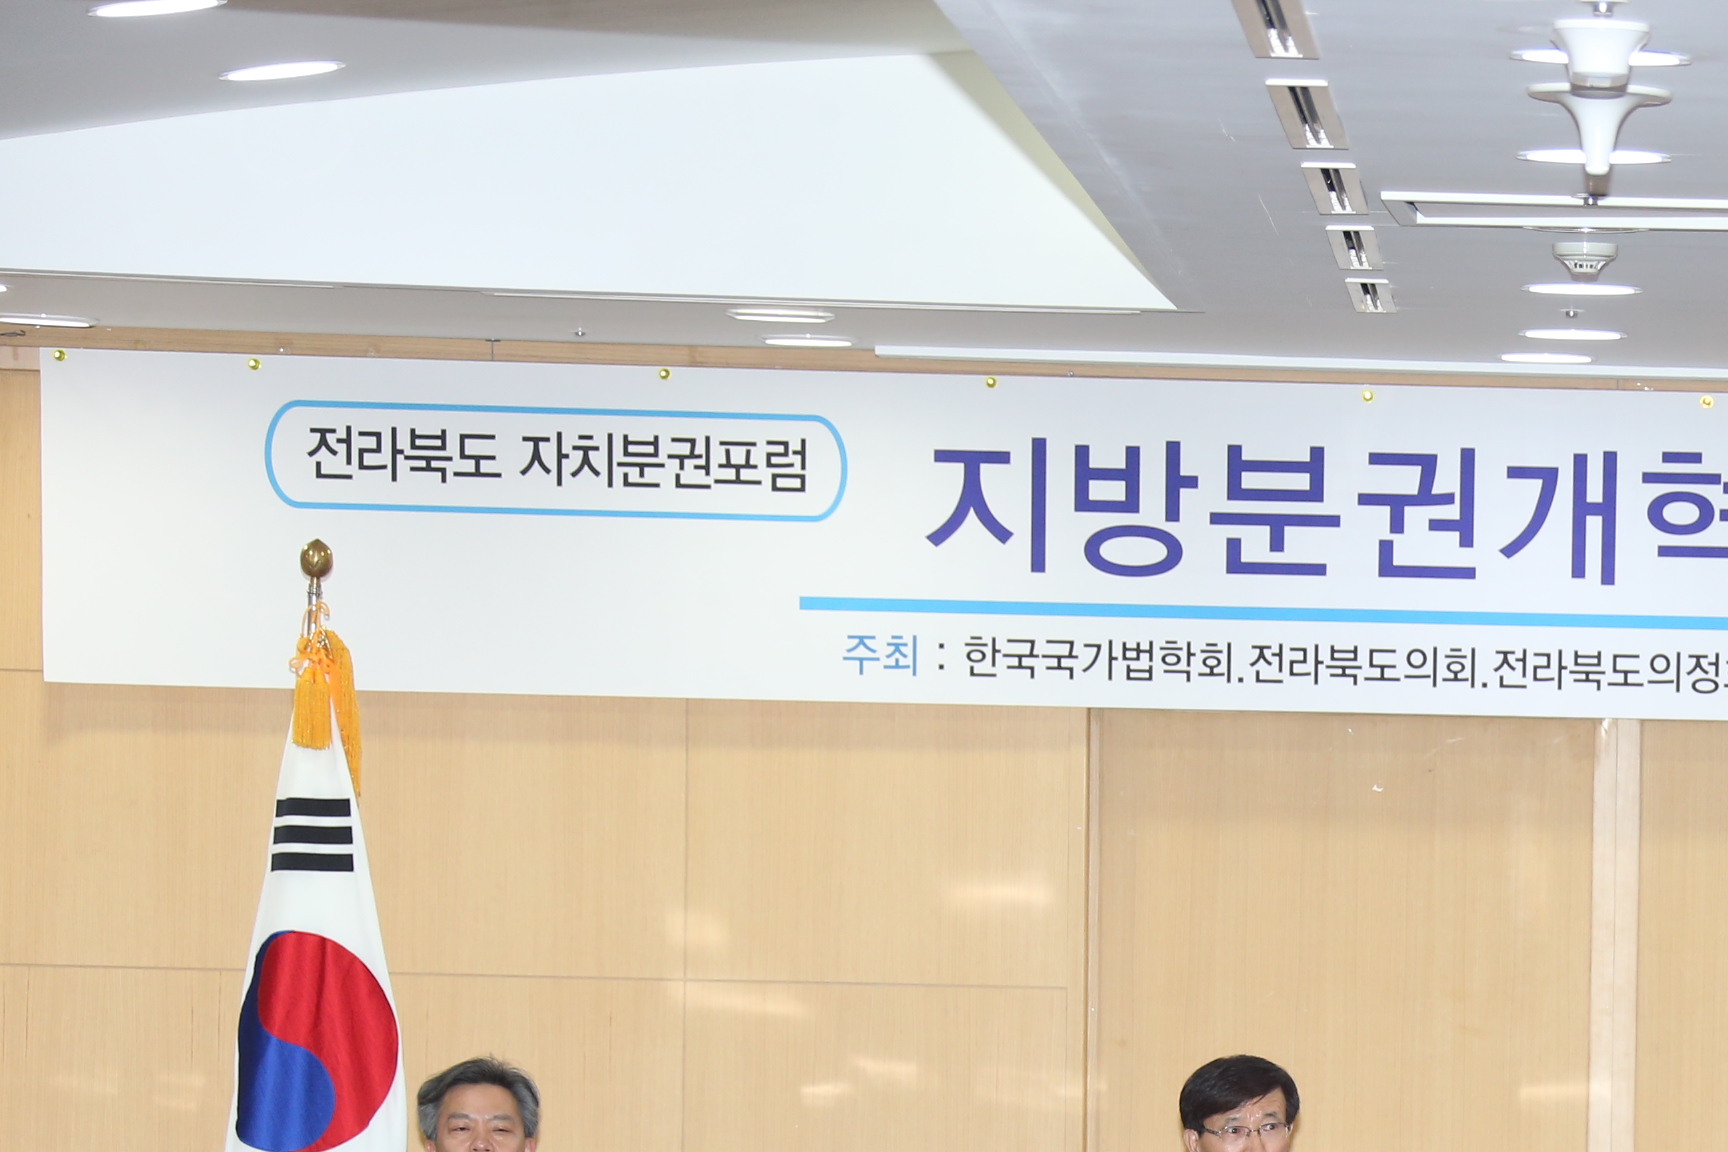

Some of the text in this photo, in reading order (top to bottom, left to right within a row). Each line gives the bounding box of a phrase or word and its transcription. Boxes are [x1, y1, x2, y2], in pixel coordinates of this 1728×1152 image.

[306, 424, 808, 493] 전라북도 자치분권포럼
[842, 634, 918, 677] 주최
